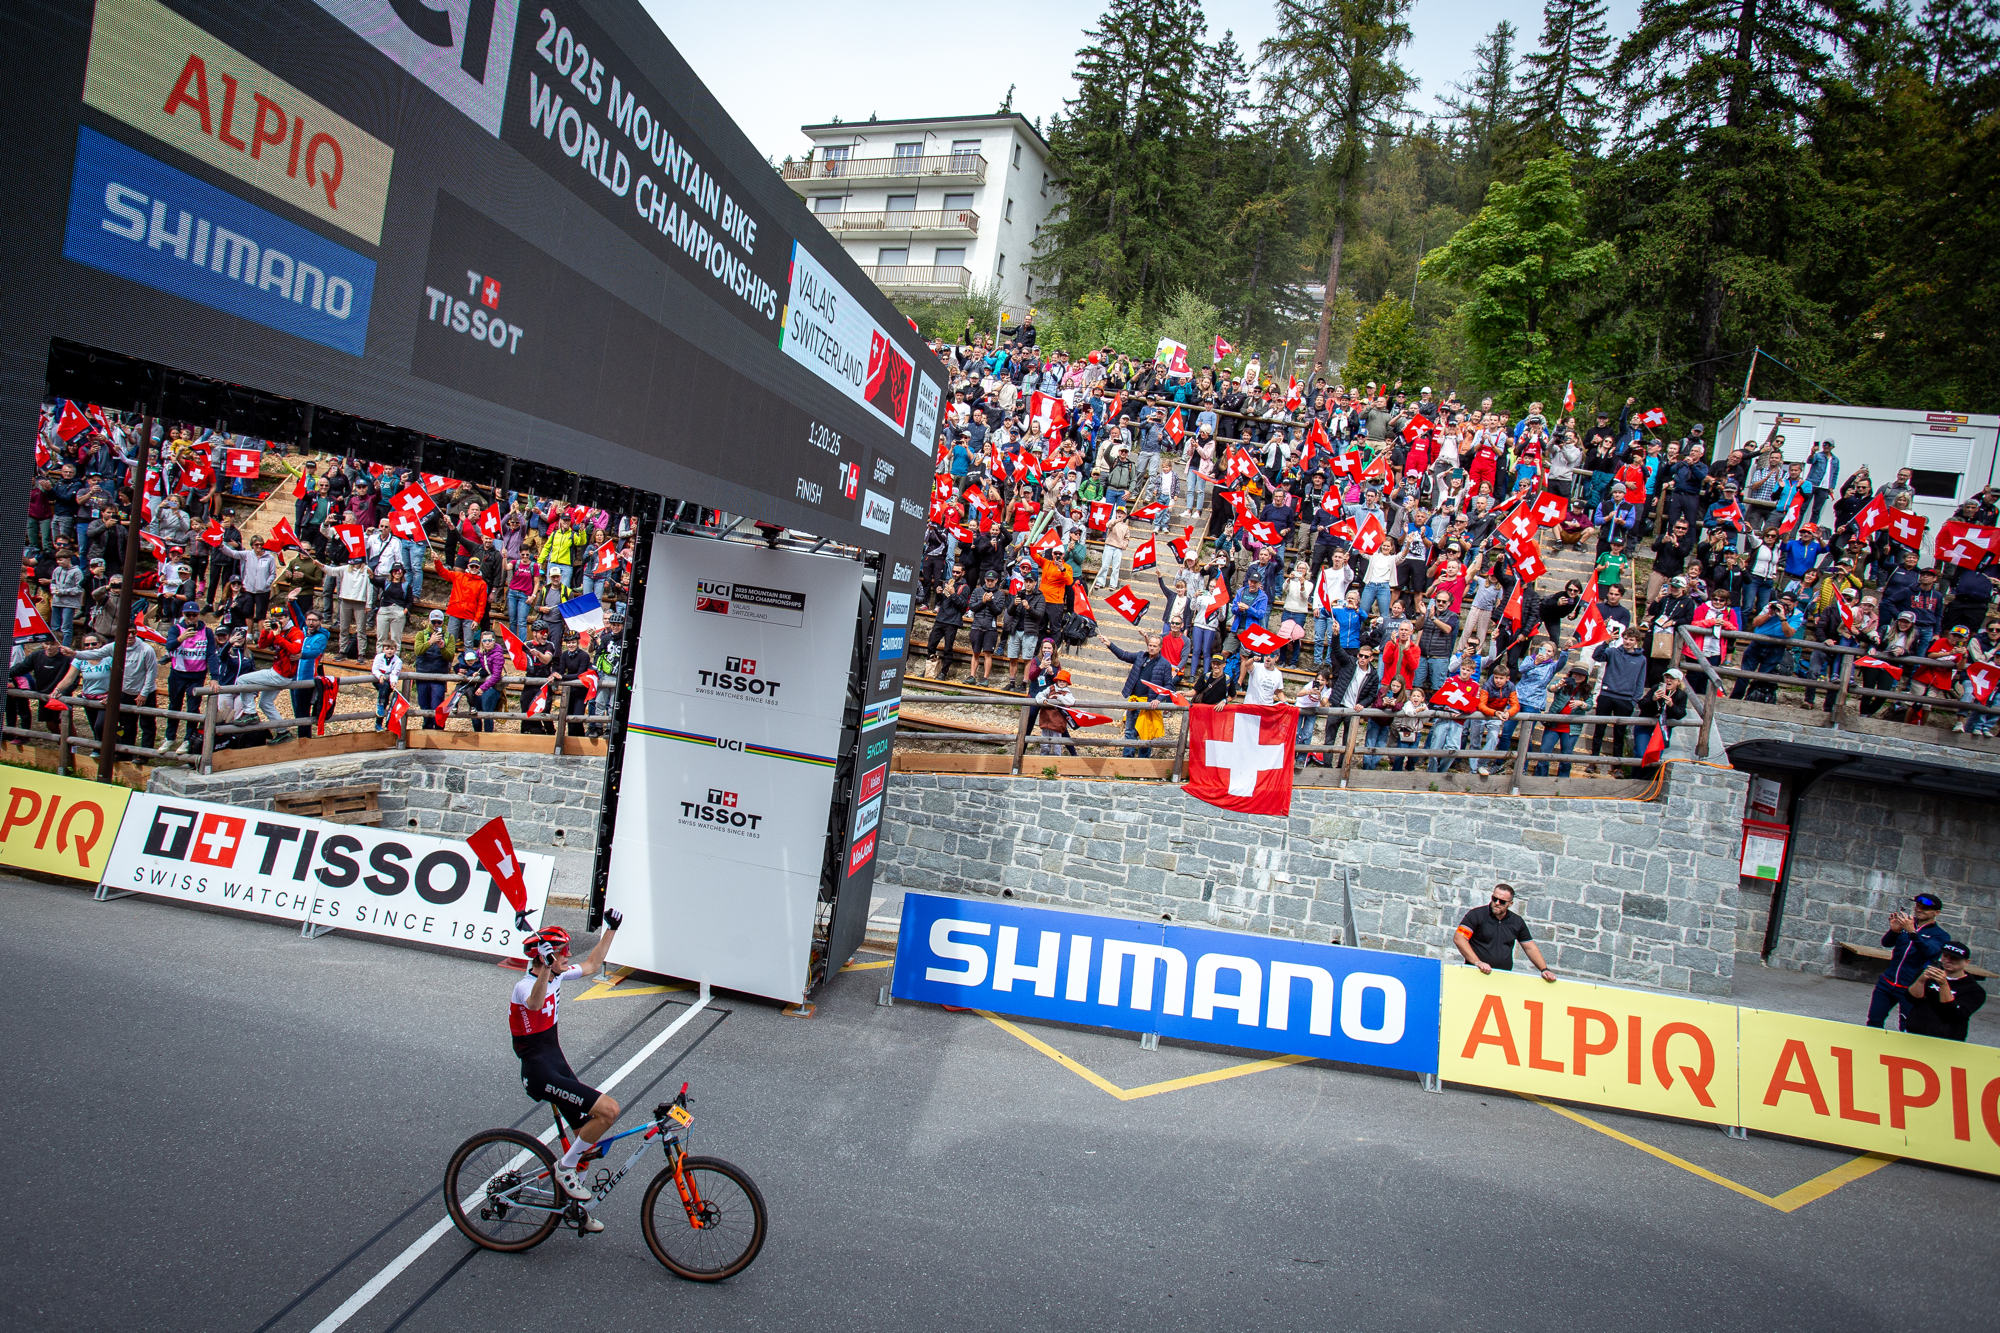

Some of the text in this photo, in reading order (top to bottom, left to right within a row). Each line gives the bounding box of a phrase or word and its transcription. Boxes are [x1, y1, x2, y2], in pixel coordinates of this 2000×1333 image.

[163, 53, 344, 210] ALPIQ
[536, 8, 757, 255] 2025 MOUNTAIN BIKE
[530, 72, 777, 321] WORLD CHAMPIONSHIPS
[102, 181, 354, 320] SHIMANO
[800, 265, 836, 324] VALAIS
[426, 286, 523, 355] TISSOT
[791, 309, 863, 387] SWITZERLAND
[921, 382, 933, 404] CRANS
[918, 398, 936, 421] MONTANA
[808, 421, 841, 456] 1:20:25
[873, 468, 887, 485] SPORT
[796, 477, 822, 504] FINISH
[872, 502, 891, 525] vittoria
[703, 582, 730, 597] UCI
[734, 593, 802, 608] WORLD CHAMPIONSHIPS
[748, 589, 779, 598] MOUNTAIN
[881, 637, 904, 651] SHIMANO
[698, 670, 780, 697] TISSOT
[715, 690, 744, 700] WATCHES
[745, 696, 763, 704] SINCE
[877, 704, 889, 723] UCI
[717, 738, 742, 752] UCI
[678, 818, 696, 827] SWISS
[698, 822, 726, 833] WATCHES
[727, 827, 745, 836] SINCE
[681, 801, 762, 830] TISSOT
[253, 821, 525, 914] TISSOT
[132, 866, 511, 946] SWISS WATCHES SINCE 1853
[925, 917, 1407, 1045] SHIMANO
[1460, 994, 1716, 1109] ALPIQ
[545, 1083, 584, 1106] EVIDEN
[1762, 1039, 2000, 1149] ALPI
[676, 1111, 686, 1120] 2
[597, 1165, 629, 1201] CUBE
